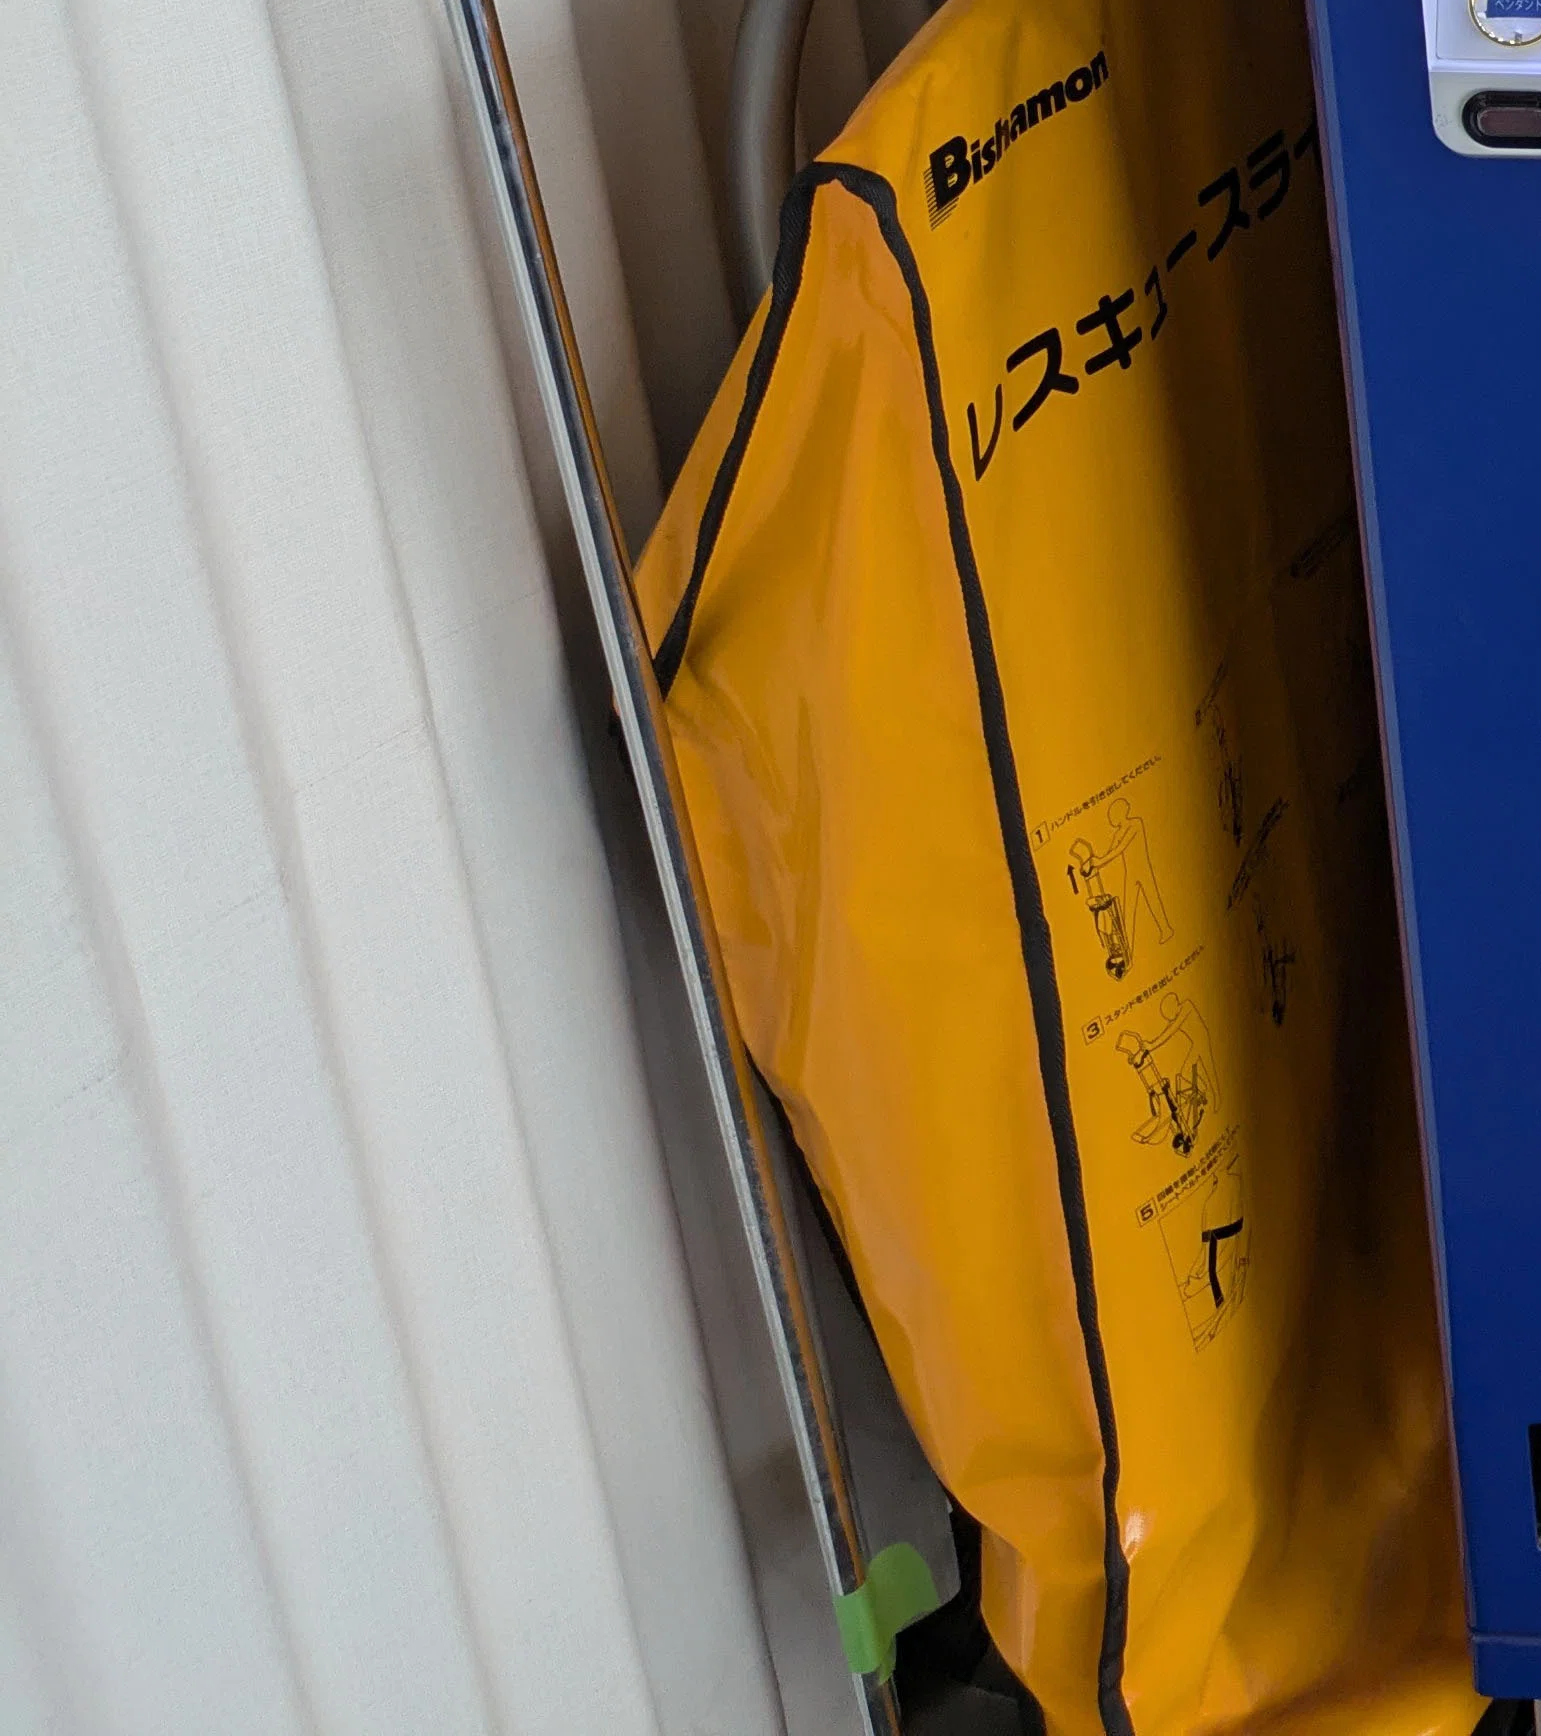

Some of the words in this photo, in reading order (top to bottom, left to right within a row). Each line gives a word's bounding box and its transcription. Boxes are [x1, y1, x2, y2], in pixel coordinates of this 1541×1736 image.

[1494, 0, 1541, 10] ペンダント
[925, 48, 1110, 217] Bishamon
[1035, 830, 1043, 843] 1
[1087, 1021, 1100, 1039] 3
[1141, 1204, 1154, 1221] 5
